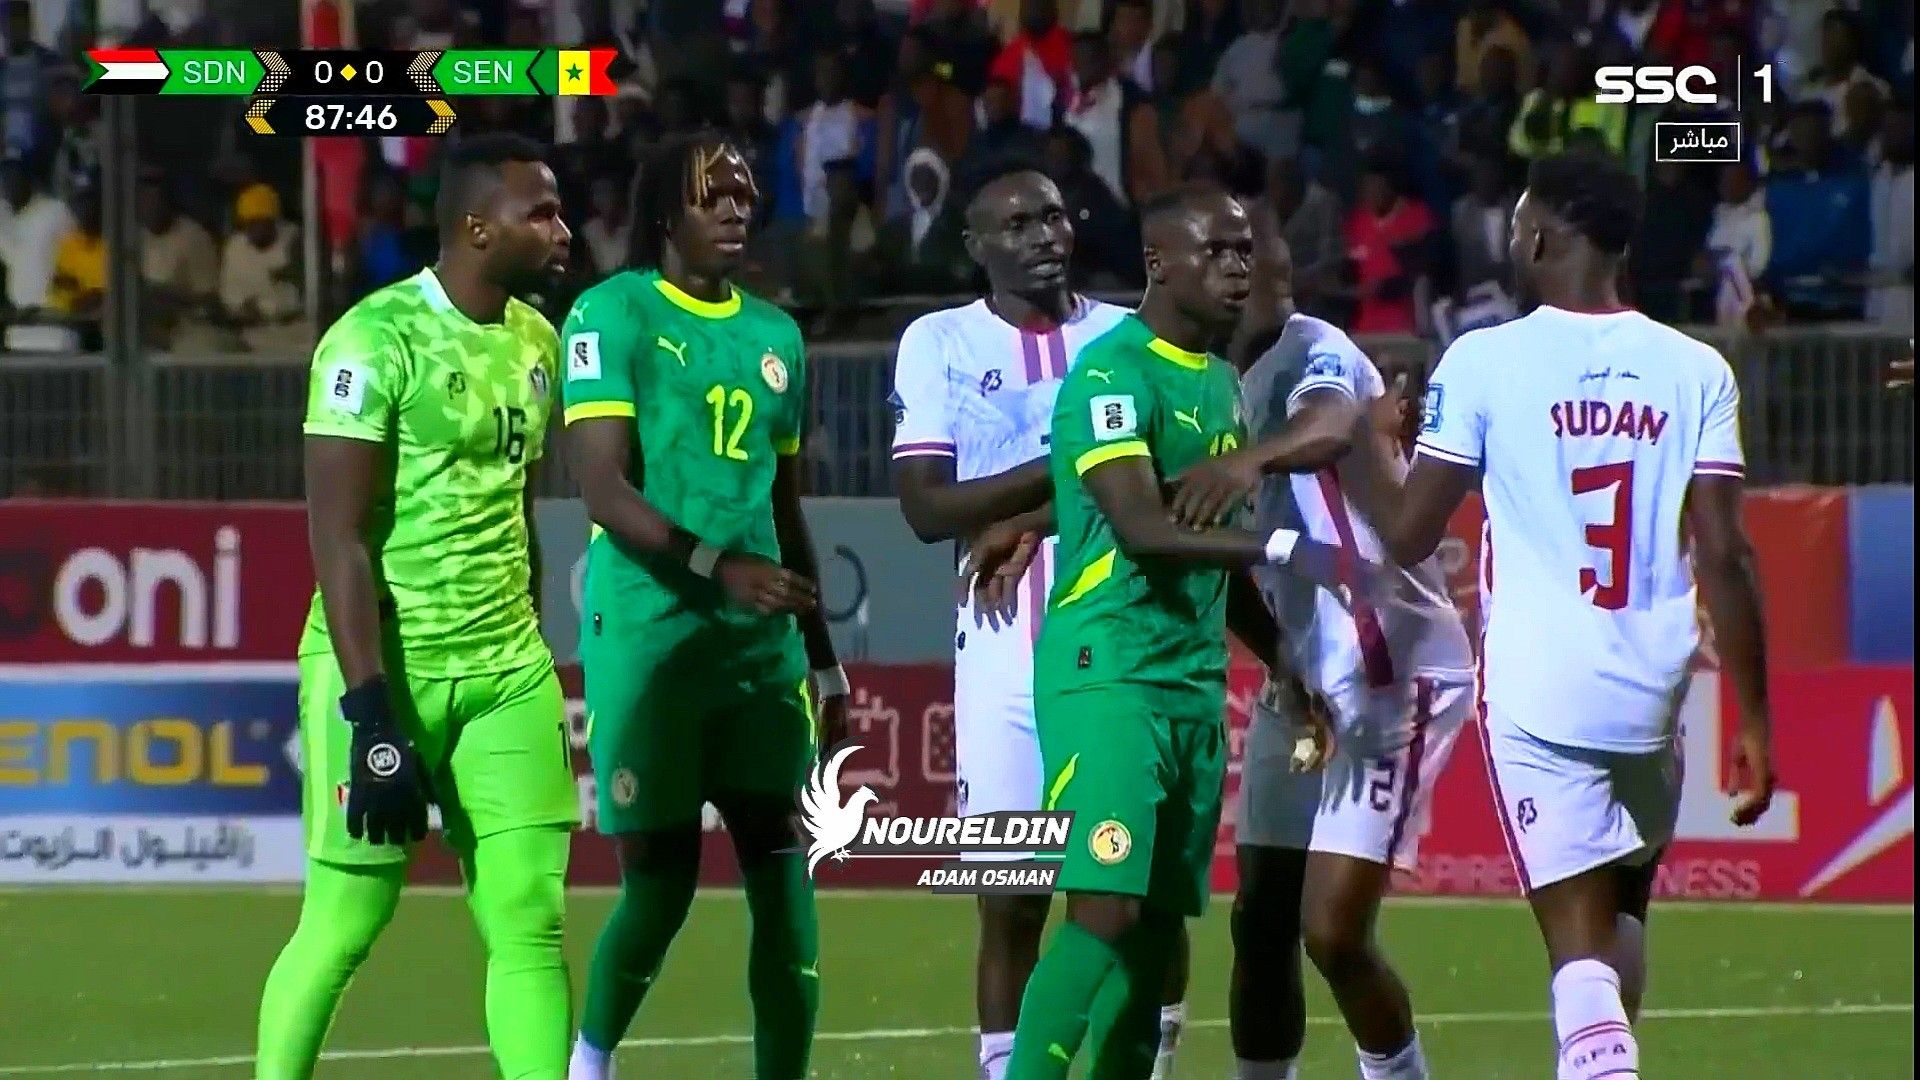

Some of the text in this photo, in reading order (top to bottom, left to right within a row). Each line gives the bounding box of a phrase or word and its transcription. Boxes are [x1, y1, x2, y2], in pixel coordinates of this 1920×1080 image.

[493, 406, 527, 464] 16
[706, 384, 753, 461] 12
[1550, 399, 1669, 446] SUDAN
[1571, 460, 1635, 611] 3
